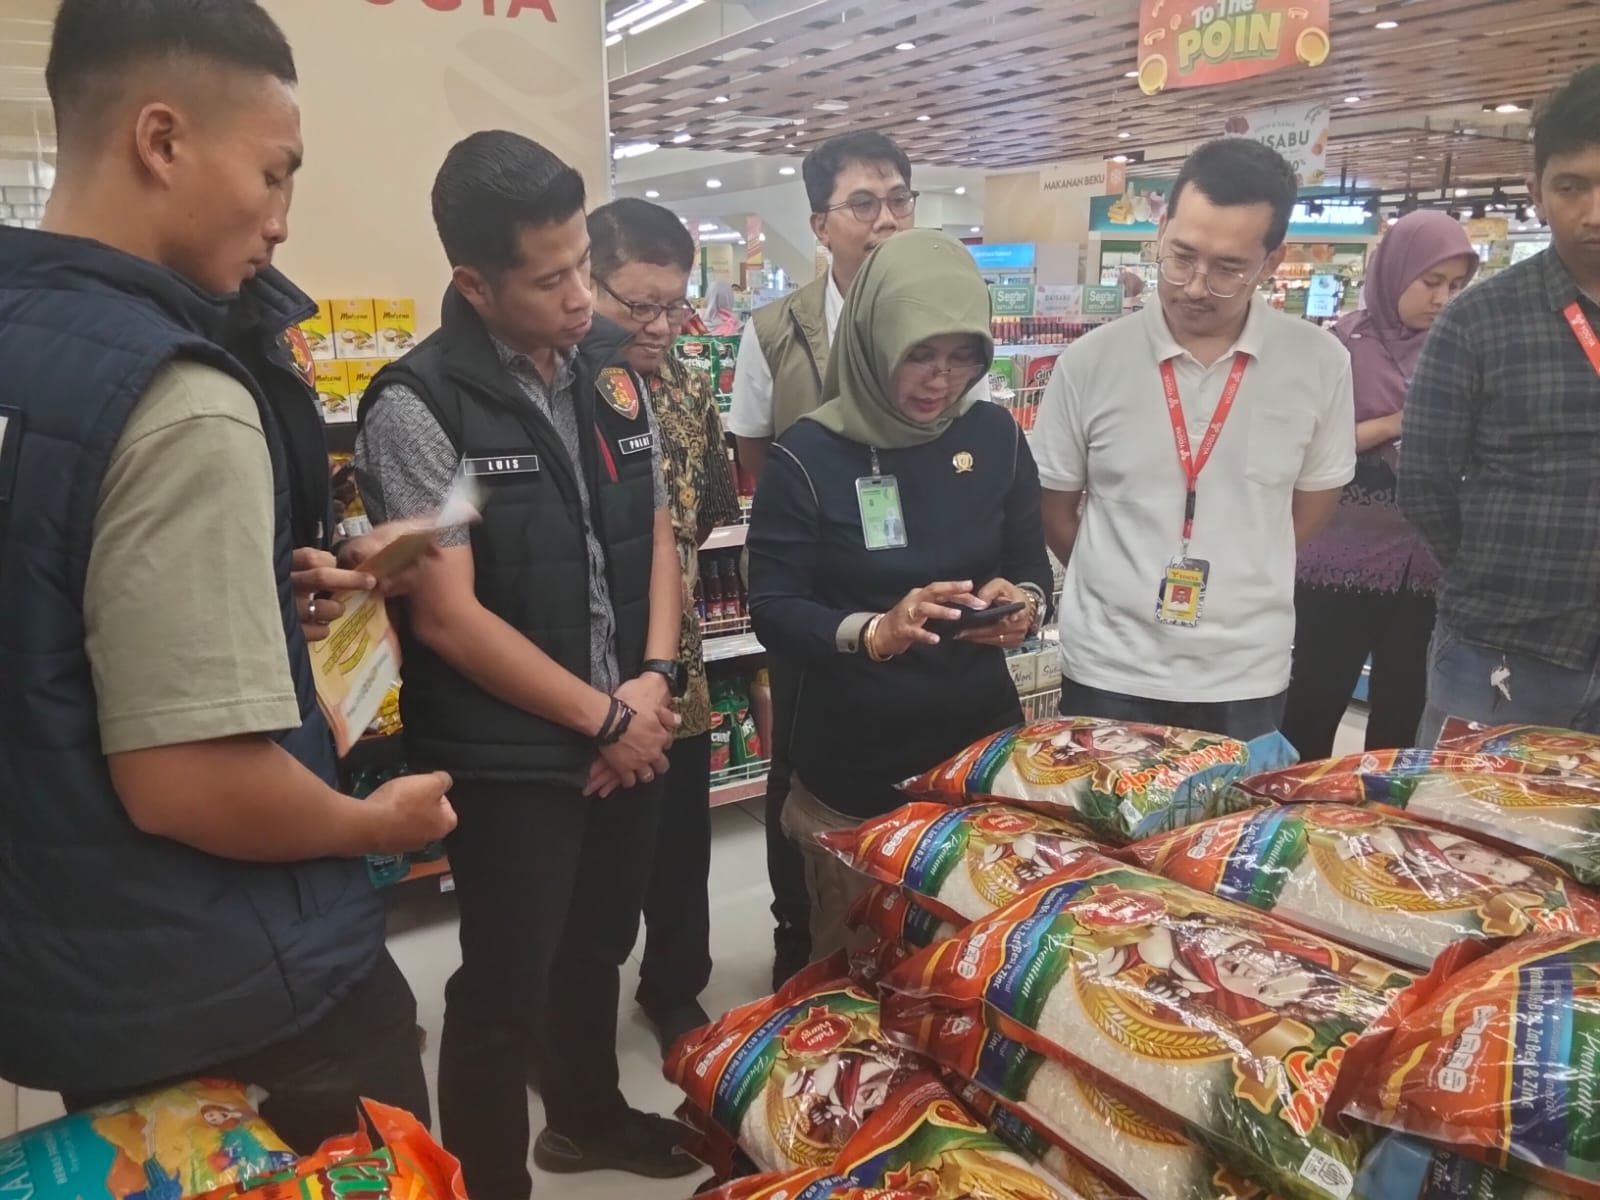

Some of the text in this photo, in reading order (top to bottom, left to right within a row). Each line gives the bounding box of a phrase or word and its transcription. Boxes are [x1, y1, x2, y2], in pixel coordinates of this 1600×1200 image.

[1191, 6, 1215, 28] To
[1178, 12, 1282, 73] POIN
[1043, 174, 1105, 191] MAKANAN BEKU
[488, 459, 519, 471] LUIS
[1020, 934, 1062, 998] Premium
[991, 968, 1007, 990] Zinc
[1526, 1028, 1542, 1042] Zat
[732, 1055, 768, 1106] Premium
[1522, 1067, 1539, 1078] &
[1577, 1029, 1600, 1118] Premium
[1520, 1079, 1537, 1109] Zinc
